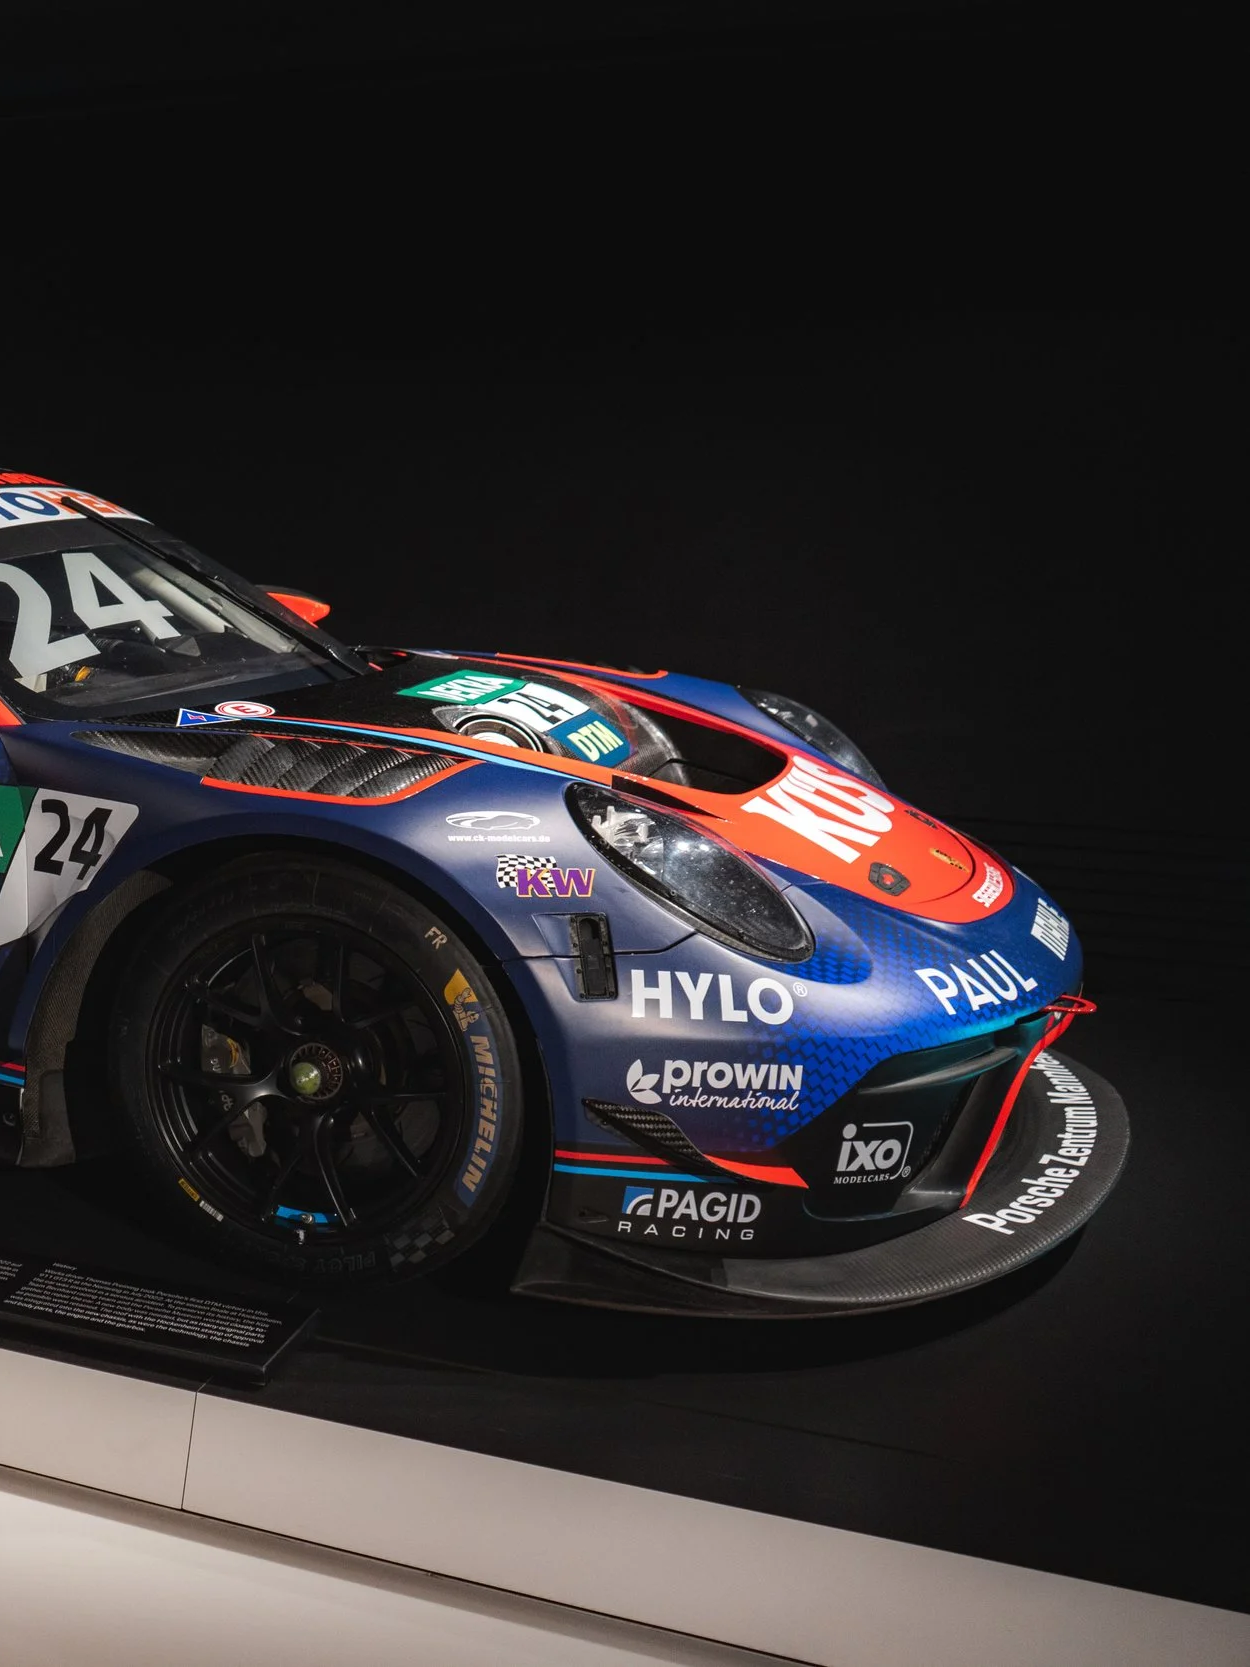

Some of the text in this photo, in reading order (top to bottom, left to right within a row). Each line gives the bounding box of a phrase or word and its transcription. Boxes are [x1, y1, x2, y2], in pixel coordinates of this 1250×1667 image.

[566, 720, 624, 763] DTM
[33, 798, 114, 881] 24
[515, 867, 596, 898] KW
[424, 925, 448, 950] FR
[914, 949, 1038, 1016] PAUL
[459, 1035, 499, 1193] MICHELIN
[669, 1088, 800, 1111] international
[833, 1172, 890, 1185] MODELCARS
[962, 1167, 1080, 1235] Porsche
[1038, 1106, 1098, 1167] Zentrum
[657, 1189, 762, 1223] PAGID
[618, 1221, 754, 1240] RACING
